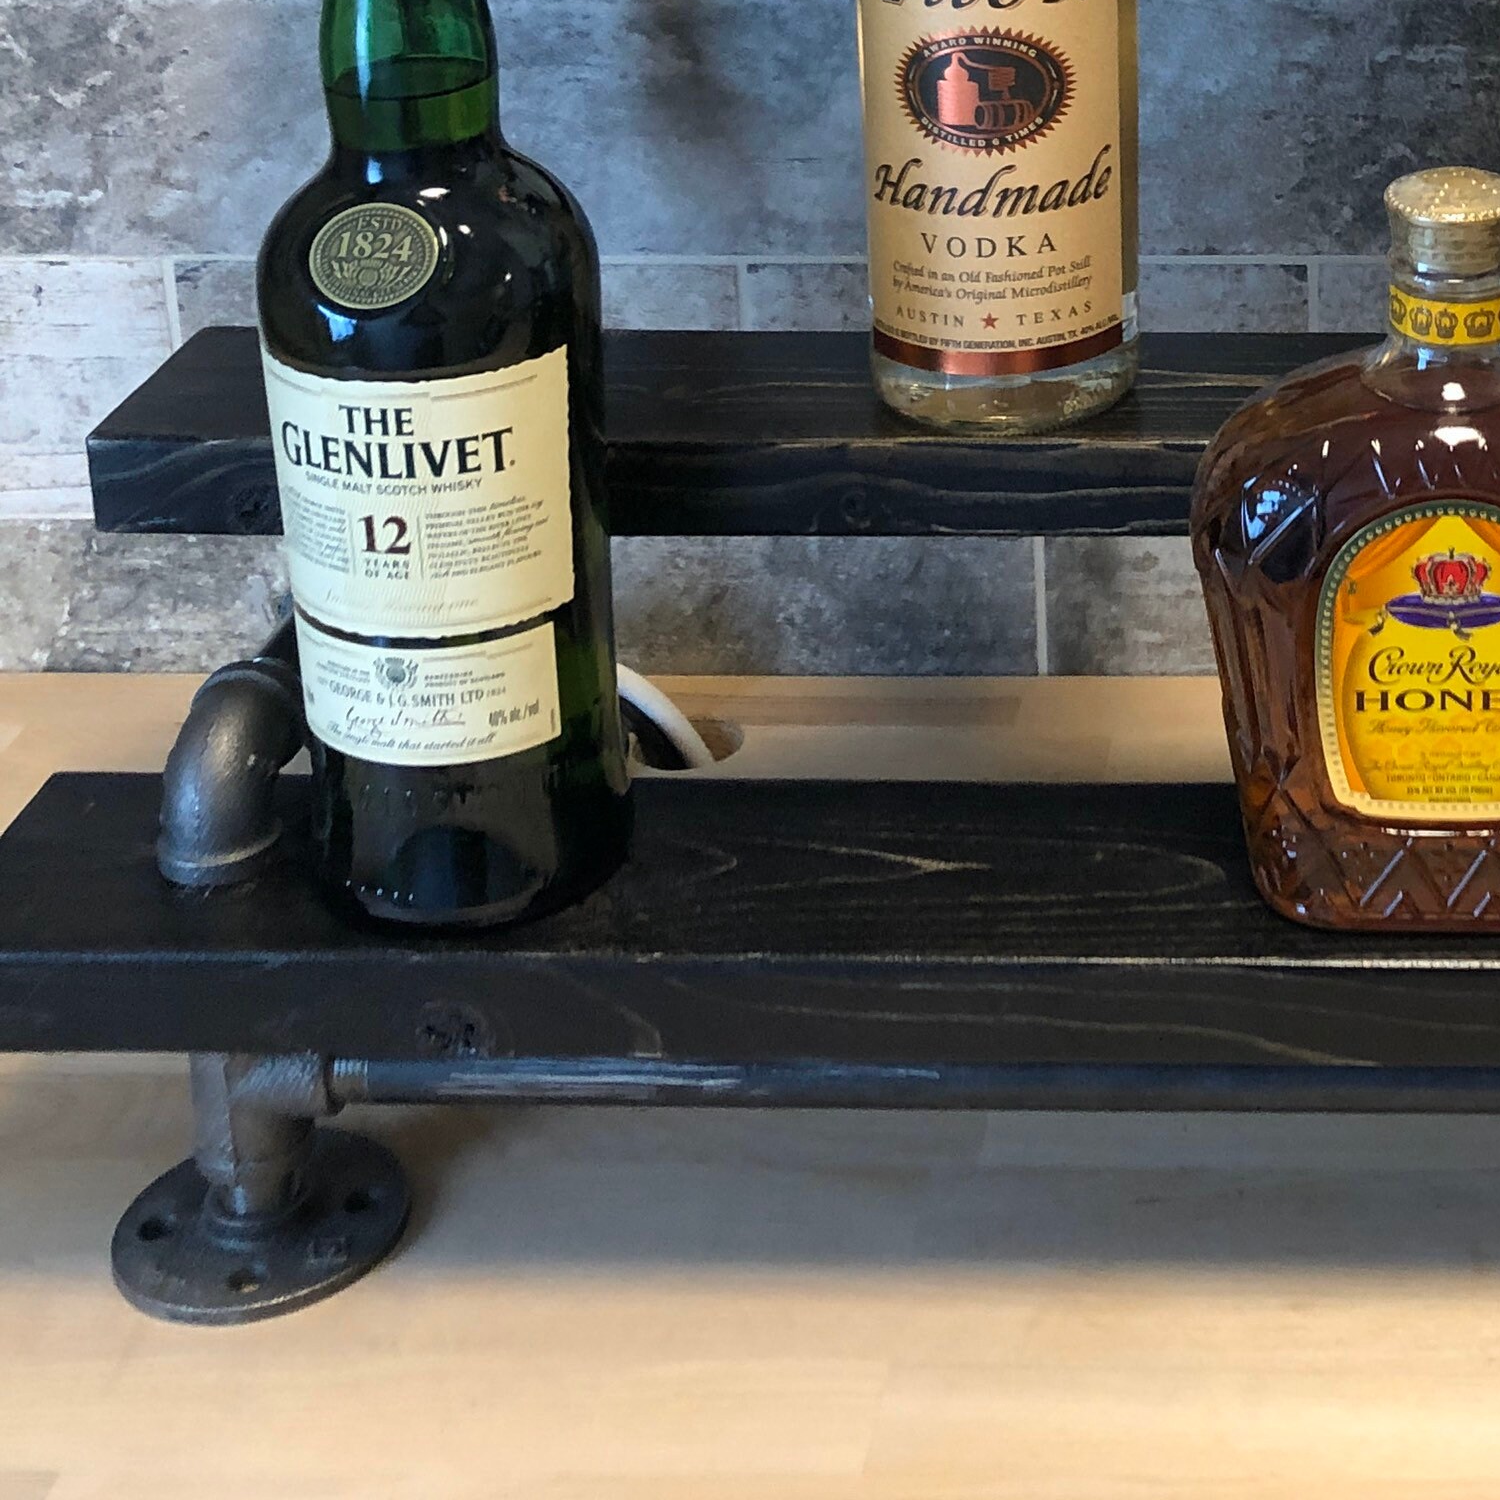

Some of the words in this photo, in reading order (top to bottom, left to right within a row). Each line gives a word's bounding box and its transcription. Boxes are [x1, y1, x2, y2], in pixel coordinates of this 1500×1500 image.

[923, 36, 967, 58] AWARD
[973, 36, 1037, 58] WINNING
[920, 116, 987, 148] DISTILLED
[992, 137, 1000, 146] 6
[1005, 116, 1045, 143] TIMES
[874, 143, 1112, 218] Handmade
[336, 230, 413, 262] 1824
[921, 232, 1057, 258] VODKA
[927, 269, 938, 280] in
[941, 272, 955, 282] an
[959, 270, 981, 283] Old
[986, 266, 1044, 283] Fashioned
[1048, 263, 1066, 277] Pot
[1069, 255, 1091, 271] Still
[903, 279, 952, 299] America's
[955, 288, 1007, 304] Original
[1011, 274, 1093, 298] Microdistillery
[896, 306, 965, 327] AUSTIN
[1016, 300, 1093, 326] TEXAS
[940, 338, 961, 349] FIFTH
[338, 404, 414, 436] THE
[305, 470, 340, 491] SINGLE
[341, 477, 372, 495] MALT
[376, 482, 427, 497] SCOTCH
[431, 476, 483, 494] WHISKY
[357, 514, 412, 556] 12
[364, 558, 410, 570] YEARS
[365, 569, 378, 579] OF
[386, 569, 410, 581] AGE
[1368, 646, 1443, 685] Crown
[329, 680, 372, 704] GEORGE
[412, 692, 455, 708] SMITH
[460, 690, 485, 706] LTD
[397, 736, 422, 750] that
[424, 734, 464, 751] started
